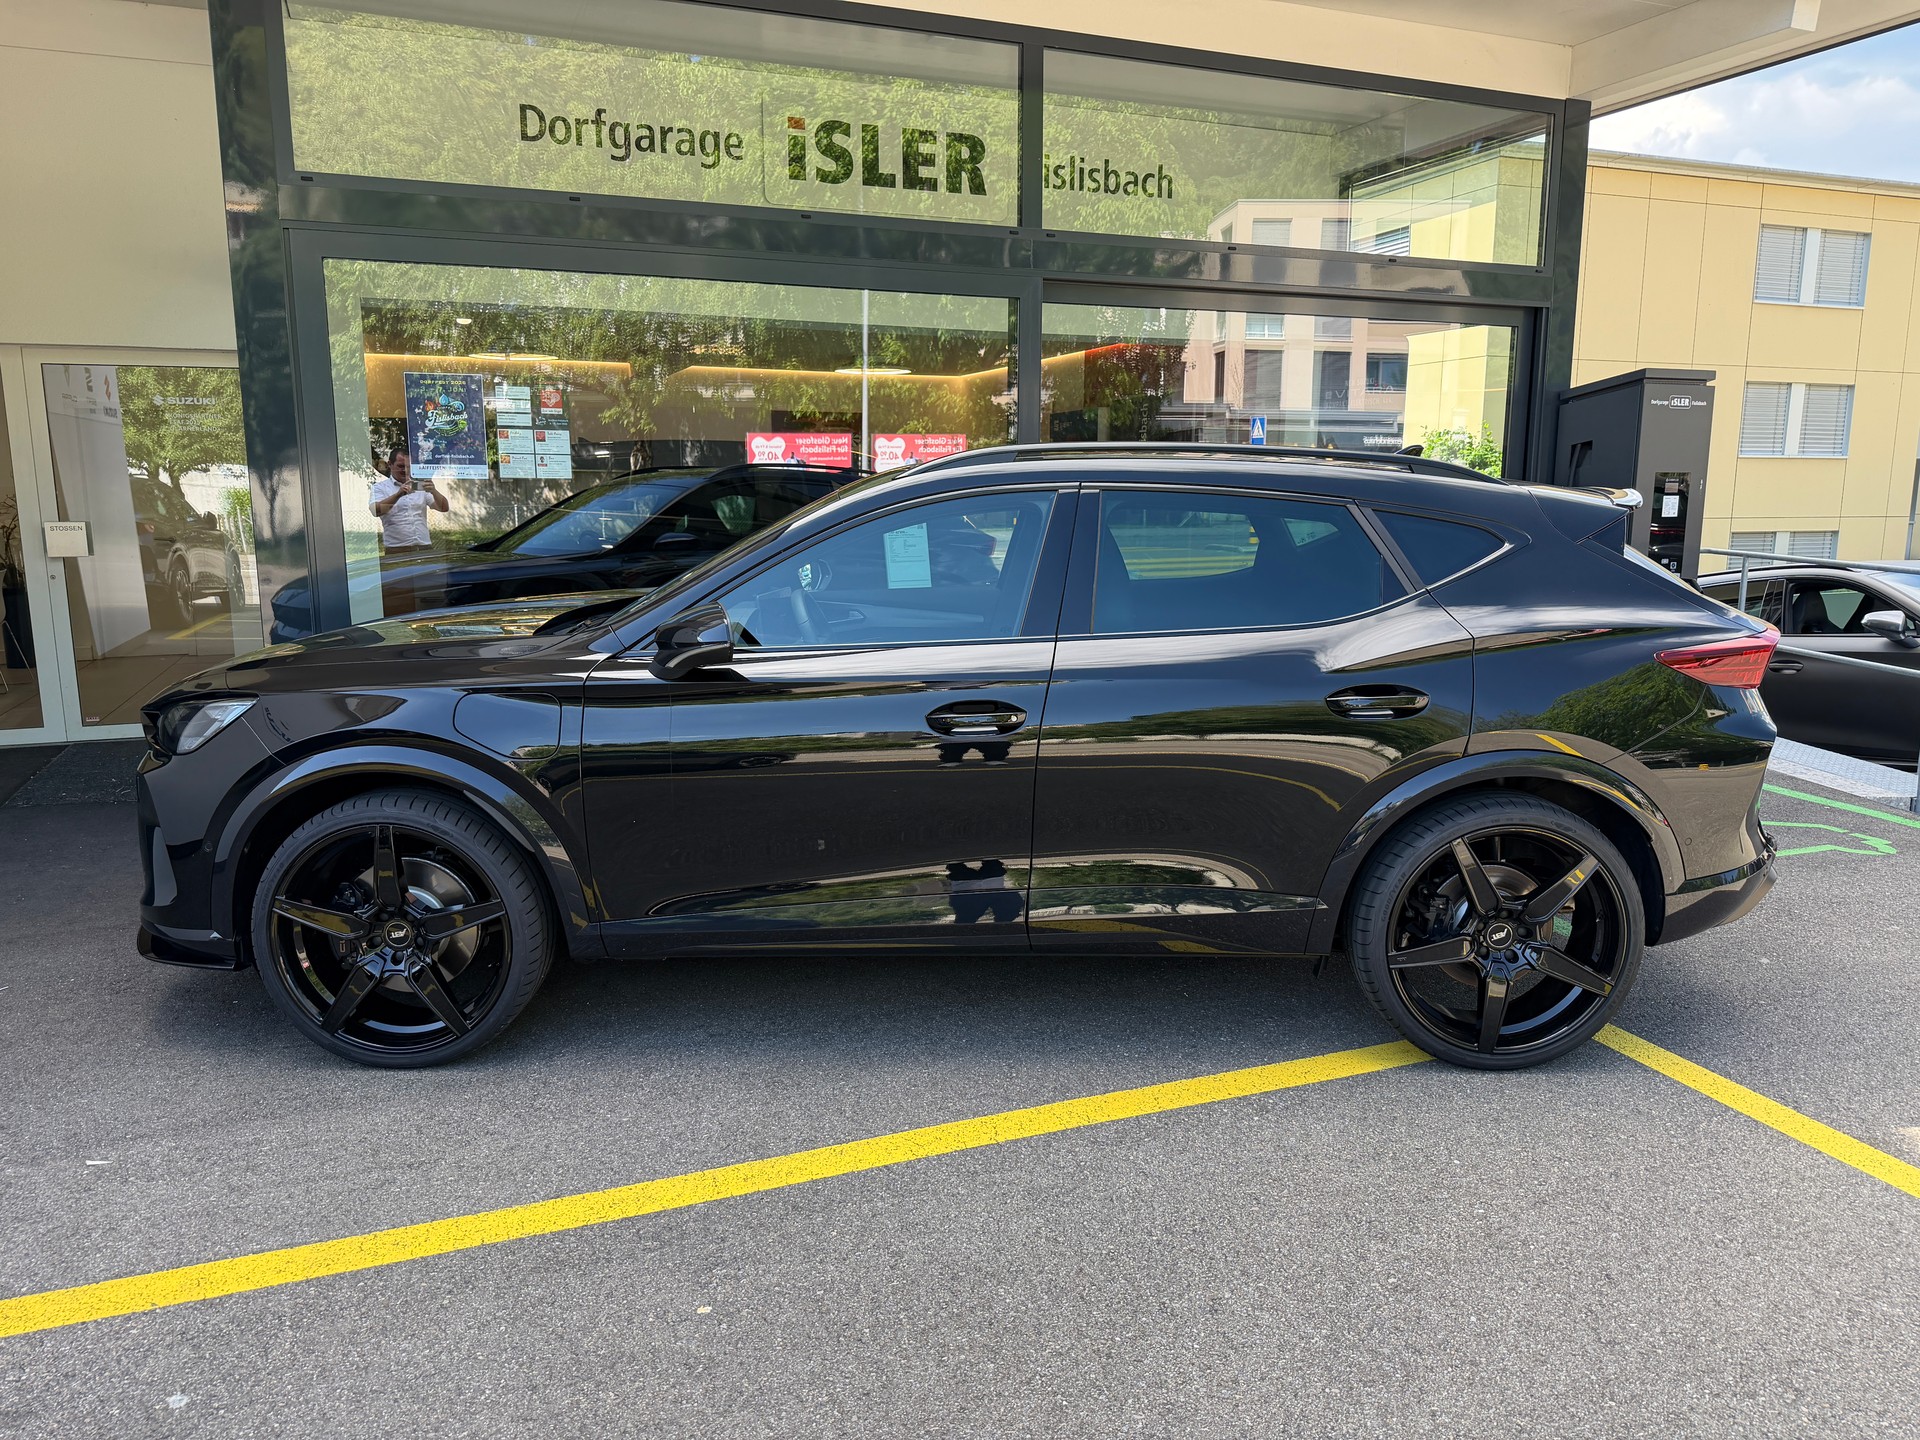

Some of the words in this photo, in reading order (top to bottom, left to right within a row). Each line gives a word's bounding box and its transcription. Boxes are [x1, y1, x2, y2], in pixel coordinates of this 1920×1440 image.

[519, 103, 743, 170] Dorfgarage
[787, 116, 987, 196] iSLER
[1043, 153, 1173, 199] islisbach
[168, 396, 216, 405] SUZUKI
[1139, 403, 1149, 442] isbach
